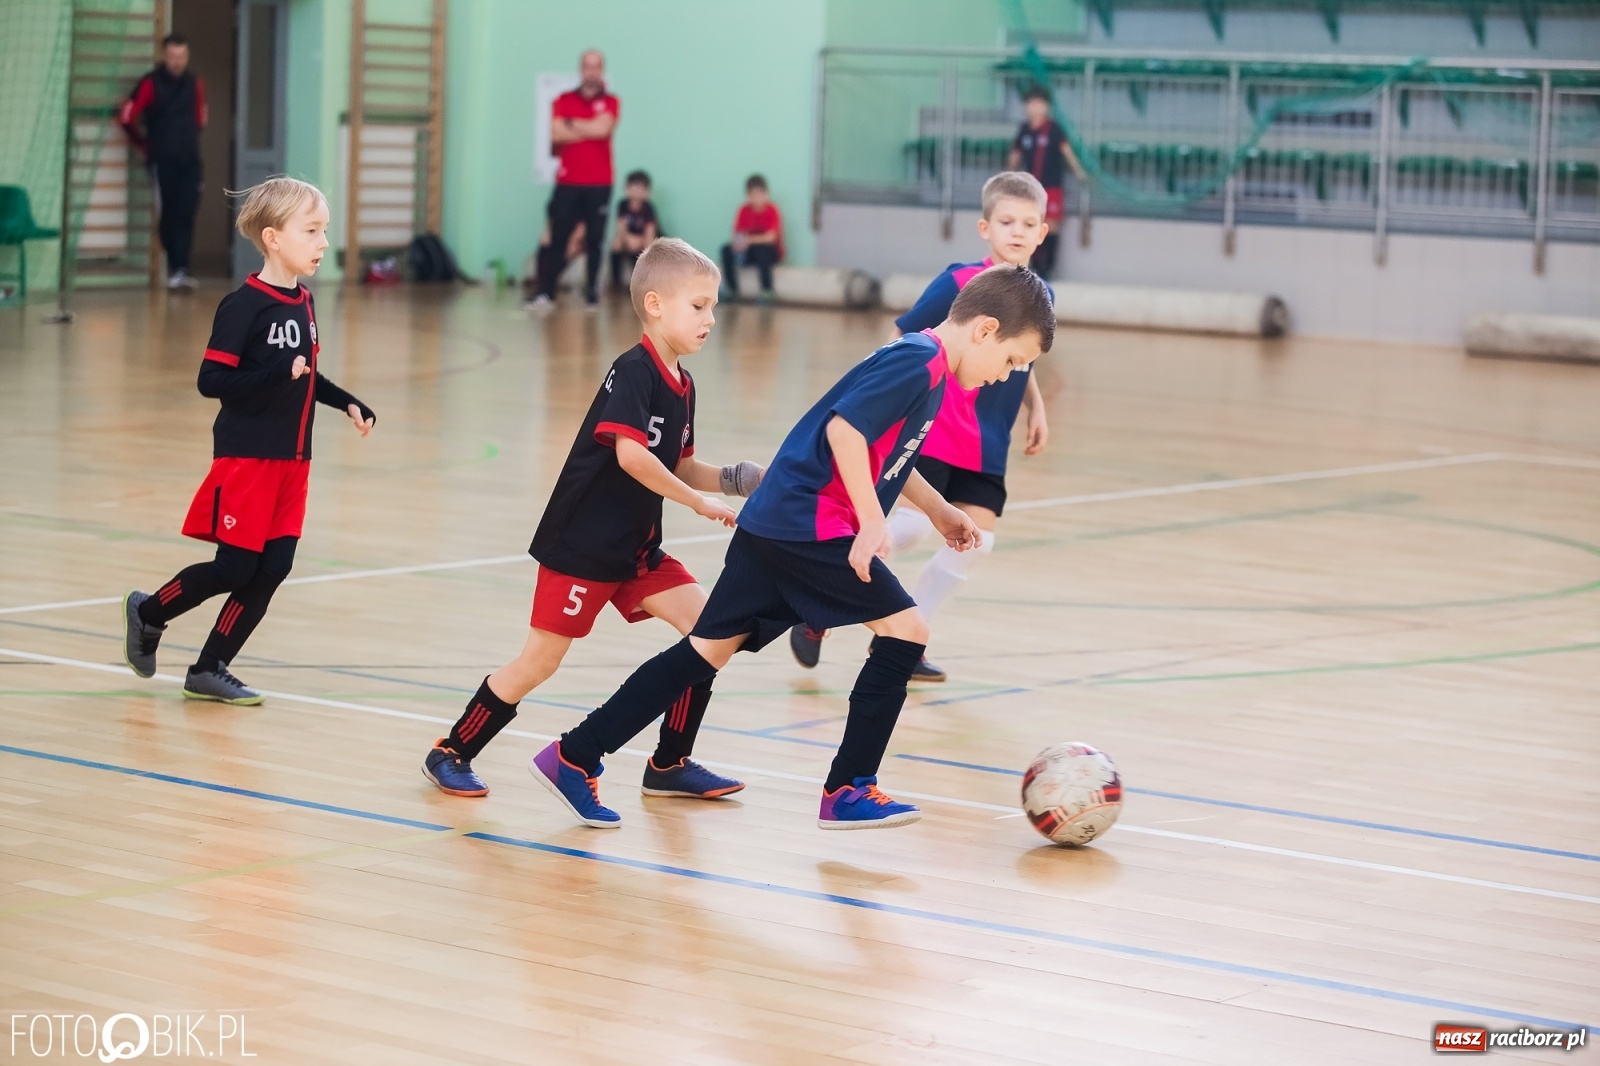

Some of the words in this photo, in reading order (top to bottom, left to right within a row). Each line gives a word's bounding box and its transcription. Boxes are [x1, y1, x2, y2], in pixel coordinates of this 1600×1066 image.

[267, 319, 301, 349] 40
[647, 415, 665, 448] 5
[562, 584, 588, 616] 5
